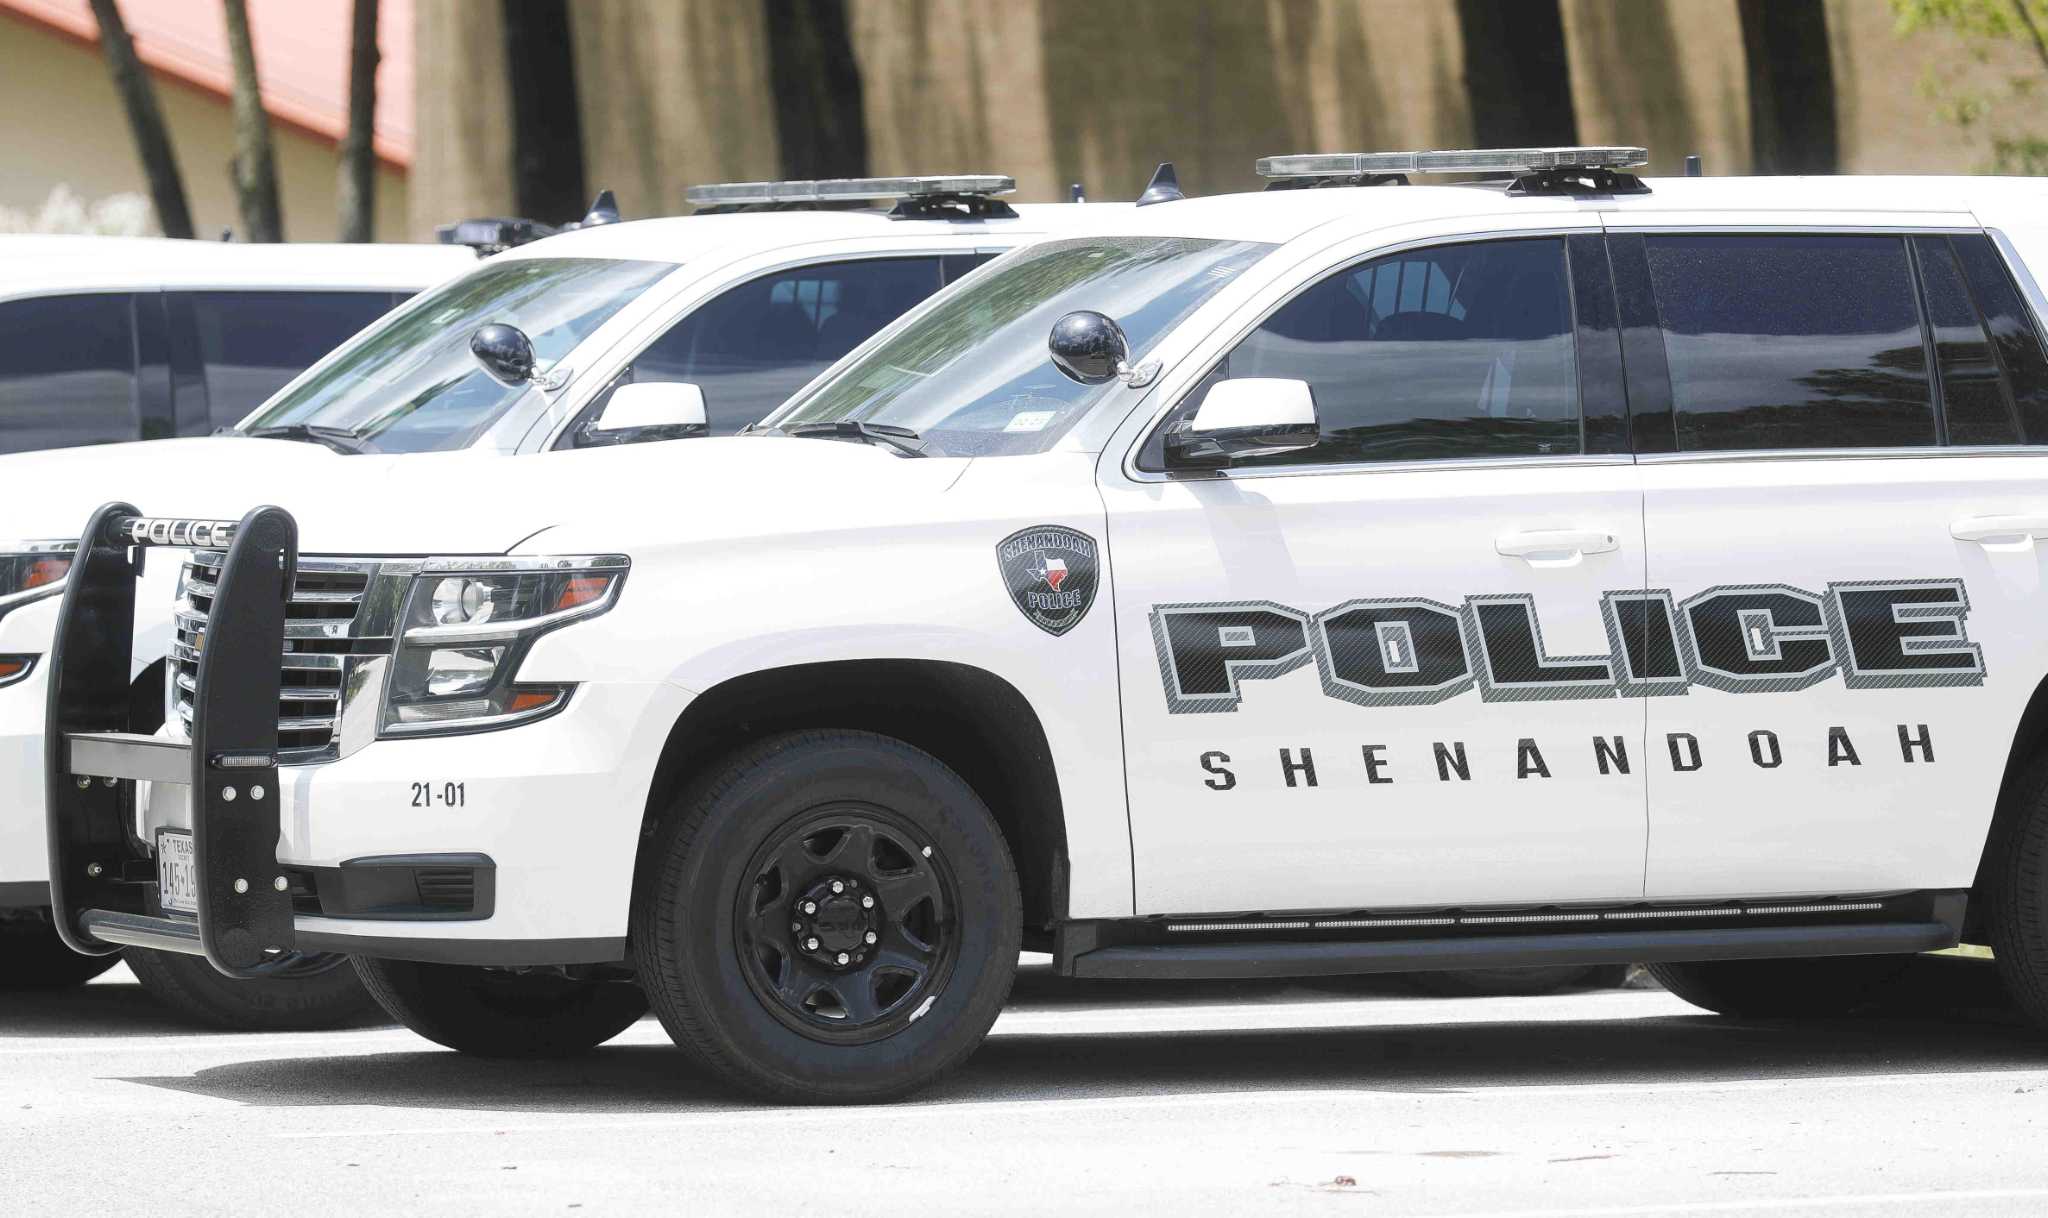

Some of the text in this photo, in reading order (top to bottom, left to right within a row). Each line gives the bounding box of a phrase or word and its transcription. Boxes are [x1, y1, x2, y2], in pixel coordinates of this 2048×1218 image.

[132, 519, 233, 546] POLICE
[1003, 532, 1092, 562] SHENANDOAH
[1027, 589, 1081, 610] POLICE
[1148, 578, 1988, 715] POLICE
[1200, 724, 1936, 791] SHENANDOAH
[411, 782, 465, 807] 21-01
[173, 839, 193, 855] TEXAS
